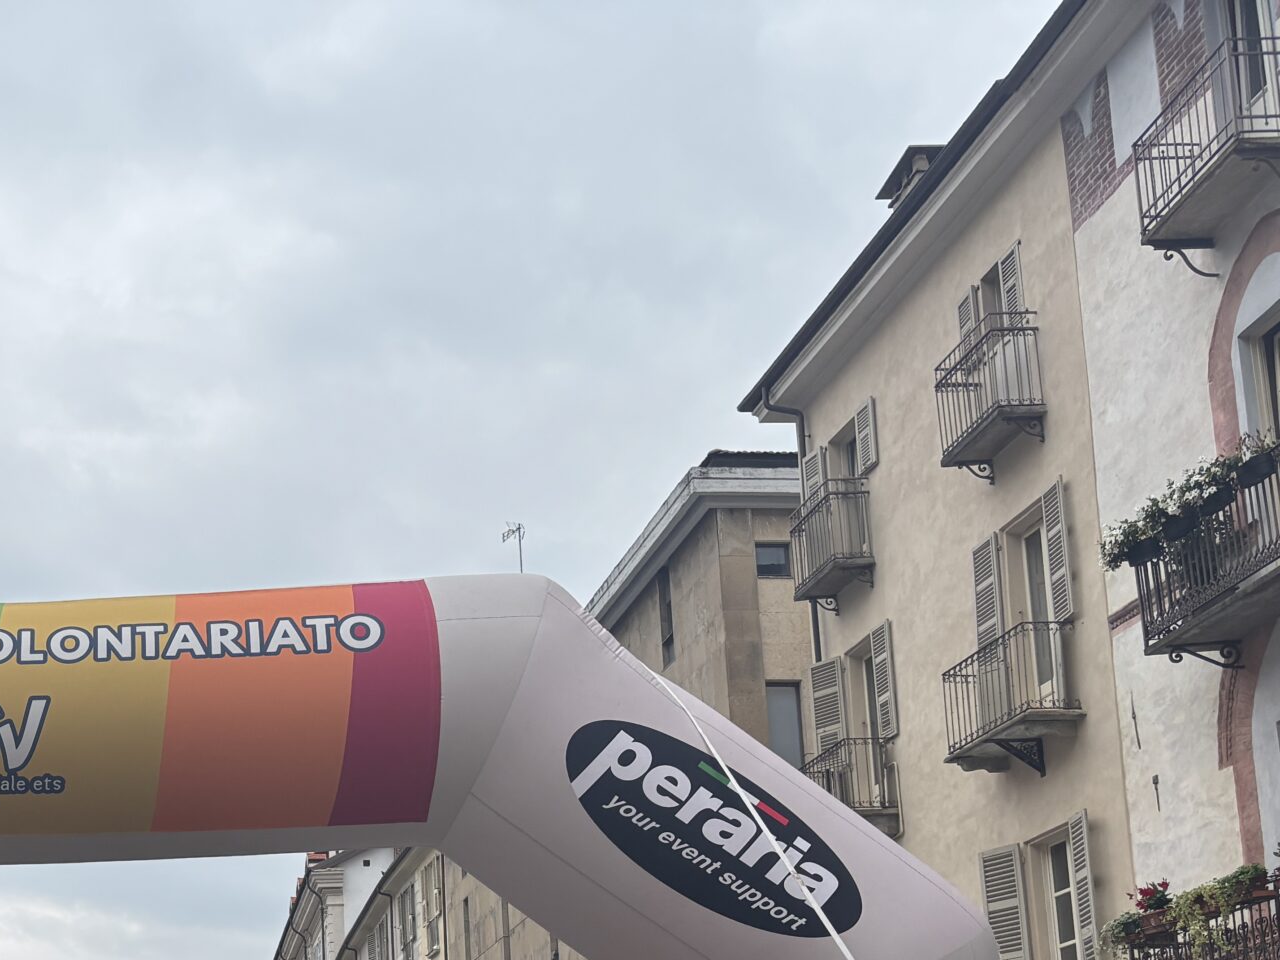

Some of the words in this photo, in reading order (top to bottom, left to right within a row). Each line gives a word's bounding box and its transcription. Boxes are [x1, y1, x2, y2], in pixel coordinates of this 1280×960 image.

[30, 776, 62, 792] ets
[570, 728, 841, 912] peraria
[601, 792, 661, 836] your
[657, 830, 722, 876] event
[718, 868, 808, 931] support
